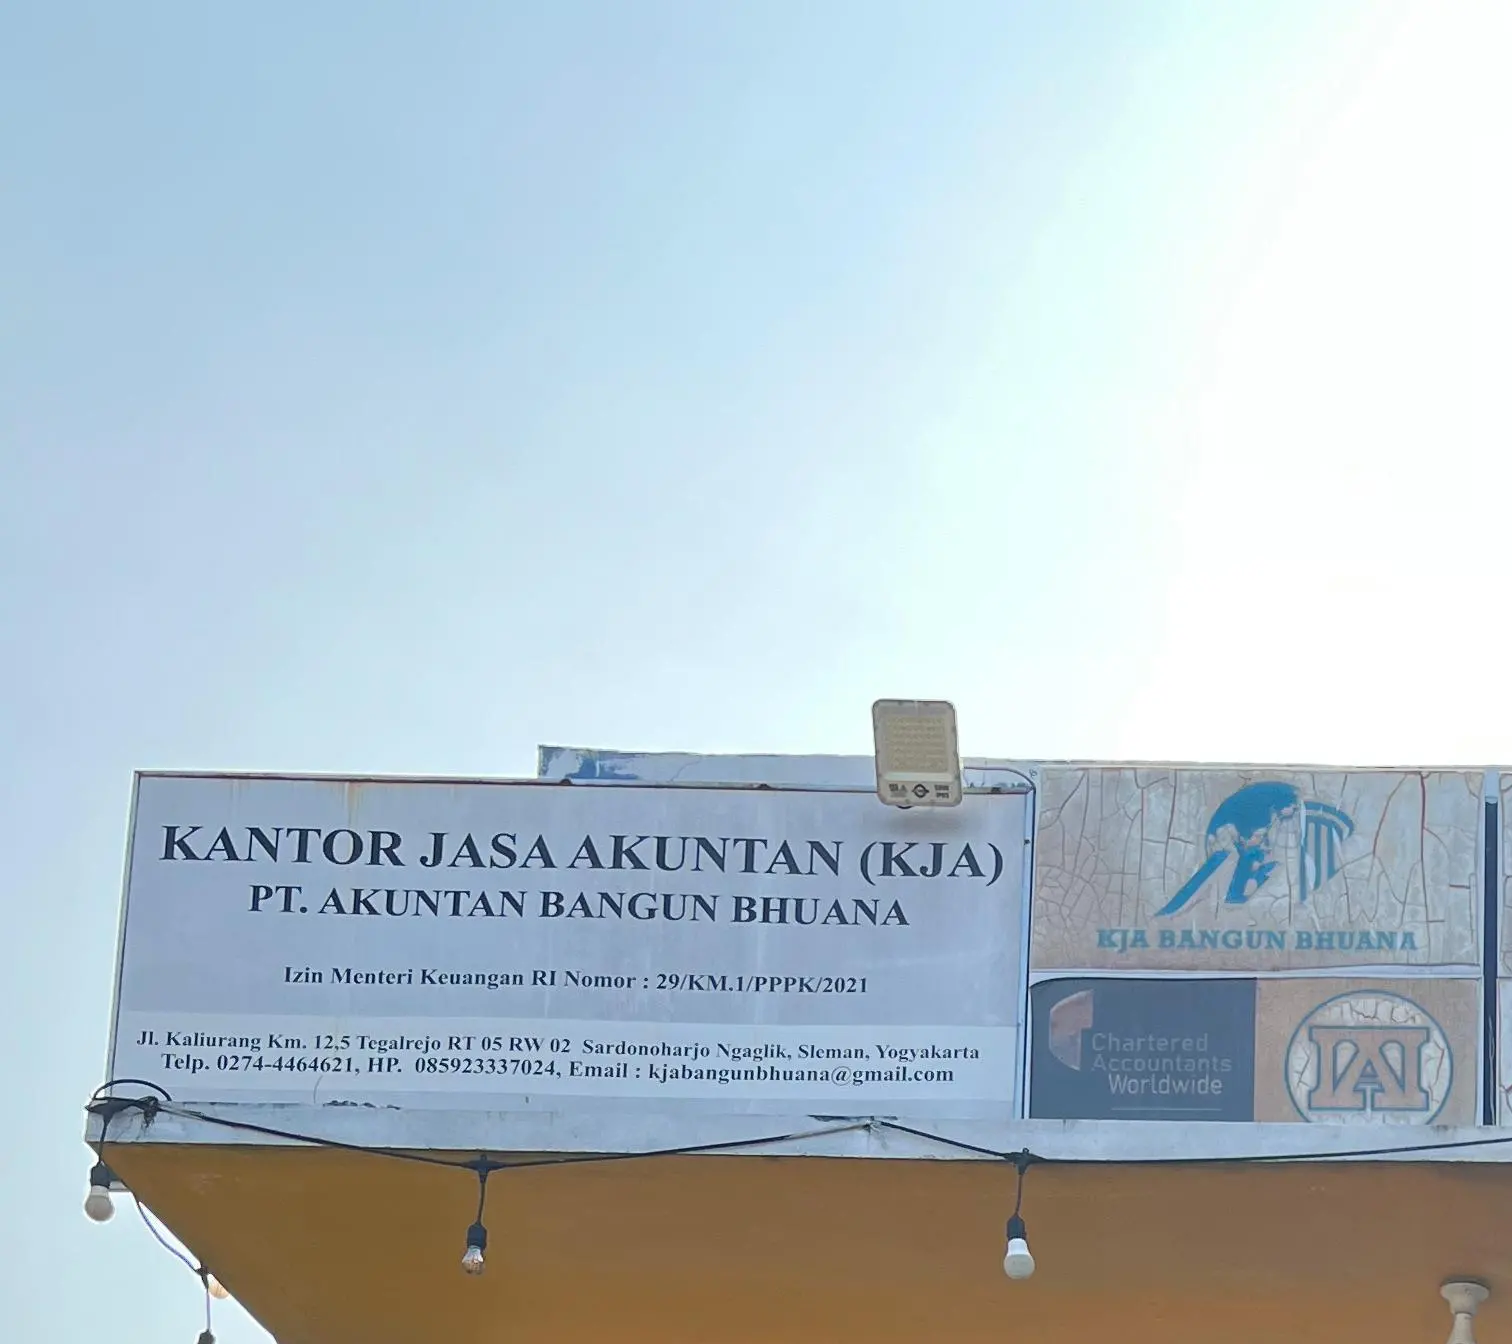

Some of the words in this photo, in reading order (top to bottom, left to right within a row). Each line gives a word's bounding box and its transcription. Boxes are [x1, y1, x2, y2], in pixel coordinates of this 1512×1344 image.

[159, 825, 406, 867] KANTOR
[419, 832, 557, 869] JASA
[566, 834, 843, 877] AKUNTAN
[860, 840, 1003, 886] (KJA)
[248, 885, 308, 914] PT.
[317, 887, 528, 918] AKUNTAN
[538, 891, 717, 923] BANGUN
[731, 895, 910, 926] BHUANA
[1096, 929, 1149, 953] KJA
[1158, 929, 1286, 950] BANGUN
[1295, 930, 1418, 951] BHUANA
[284, 966, 323, 984] Izin
[331, 967, 413, 985] Menteri
[420, 969, 524, 989] Keuangan
[531, 969, 557, 986] RI
[563, 970, 637, 989] Nomor
[656, 973, 868, 993] 29/KM.1/PPPK/2021
[136, 1031, 158, 1046] Jl.
[165, 1032, 261, 1051] Kaliurang
[268, 1034, 307, 1049] Km.
[315, 1034, 350, 1051] 12,5
[356, 1035, 441, 1053] Tegalrejo
[449, 1036, 476, 1050] RT
[481, 1036, 503, 1051] 05
[509, 1037, 544, 1052] RW
[550, 1038, 571, 1053] 02
[582, 1039, 710, 1060] Sardonoharjo
[716, 1043, 792, 1062] Ngaglik,
[797, 1044, 870, 1061] Sleman,
[875, 1044, 979, 1063] Yogyakarta
[1092, 1033, 1208, 1052] Chartered
[161, 1053, 210, 1074] Telp.
[216, 1055, 361, 1076] 0274-4464621,
[367, 1057, 402, 1073] HP.
[415, 1057, 562, 1079] 085923337024,
[569, 1061, 628, 1079] Email
[648, 1064, 955, 1086] kjabangunbhuana@gmail.com
[1090, 1053, 1232, 1072] Accountants
[1108, 1073, 1223, 1095] Worldwide
